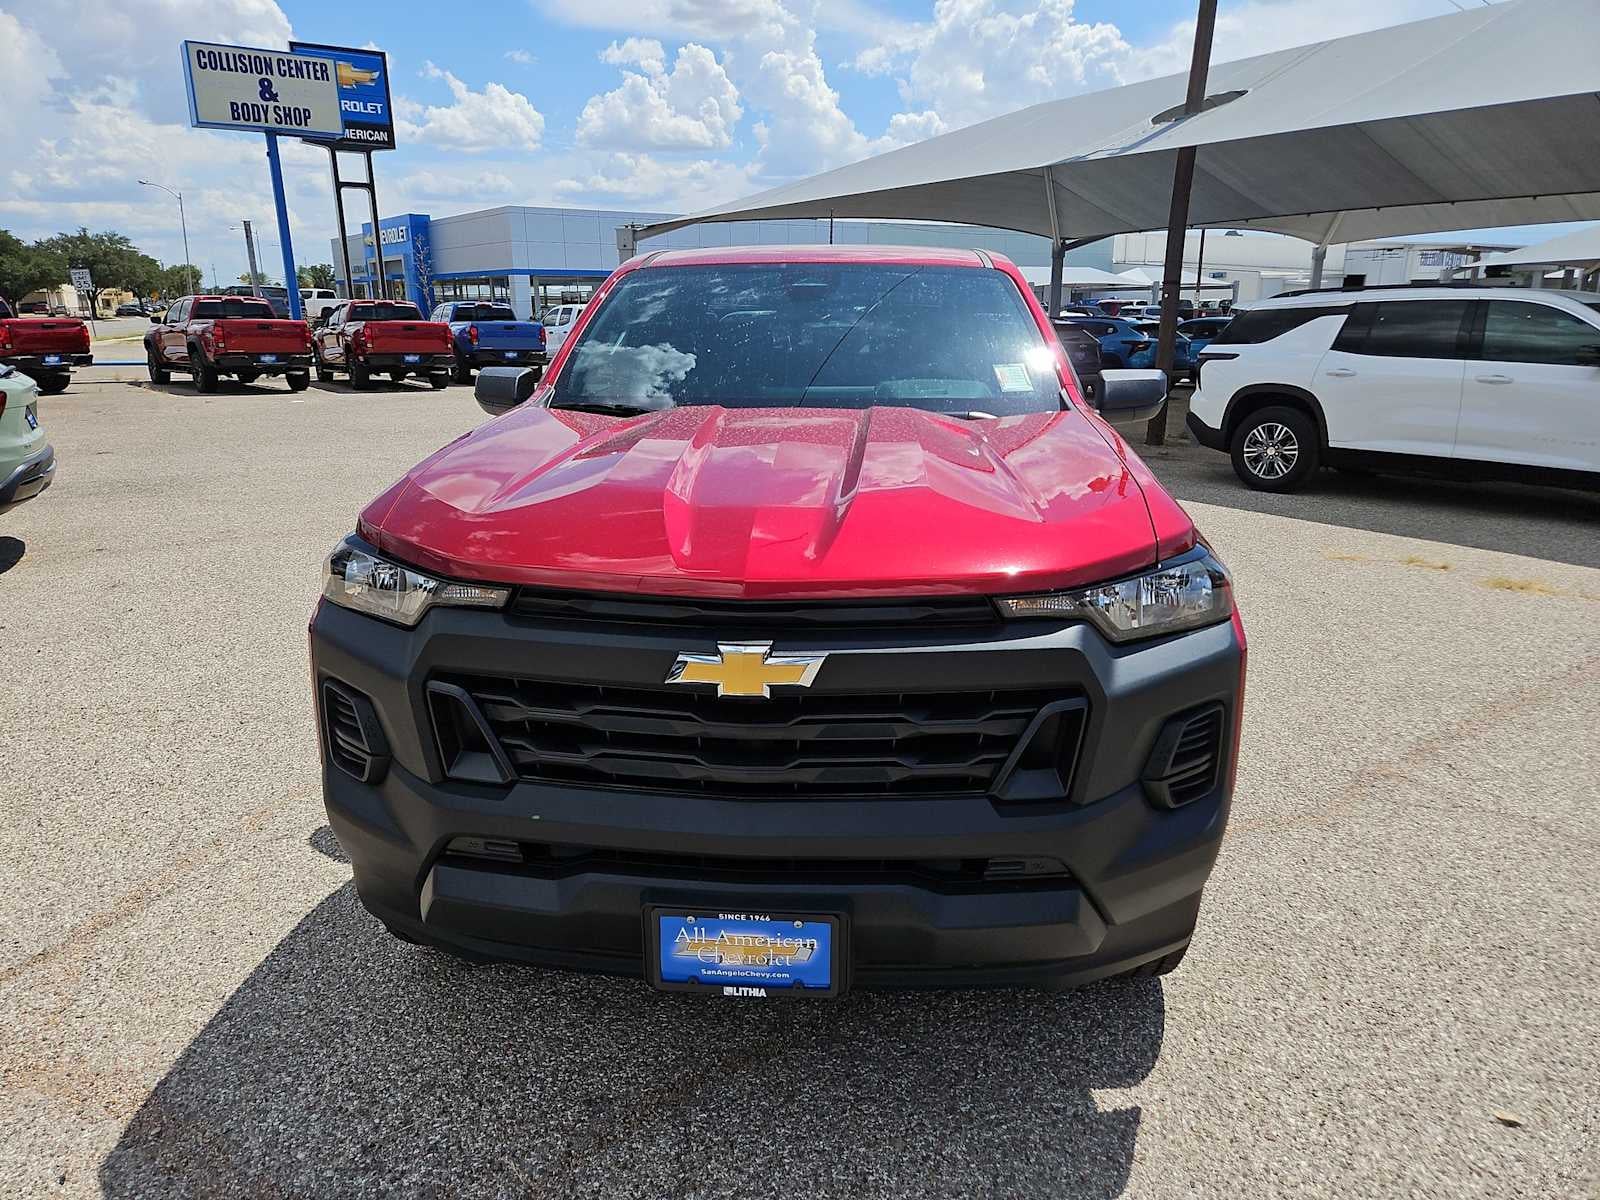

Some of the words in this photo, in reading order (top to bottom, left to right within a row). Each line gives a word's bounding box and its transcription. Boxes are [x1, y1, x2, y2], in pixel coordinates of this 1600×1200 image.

[196, 49, 274, 76] COLLISION
[277, 57, 330, 82] CENTER
[258, 77, 279, 103] &
[229, 101, 269, 124] BODY
[273, 105, 311, 127] SHOP
[340, 99, 383, 115] ROLET
[344, 128, 388, 142] MERICAN
[381, 226, 407, 245] EVROLET
[76, 280, 91, 289] 35
[718, 913, 747, 921] SINCE
[749, 914, 771, 922] 1946
[674, 927, 706, 944] All
[713, 930, 818, 949] American
[697, 946, 792, 967] Chevrolet
[701, 968, 790, 979] SanAngeloChevy.com
[733, 986, 767, 998] LITHIA
